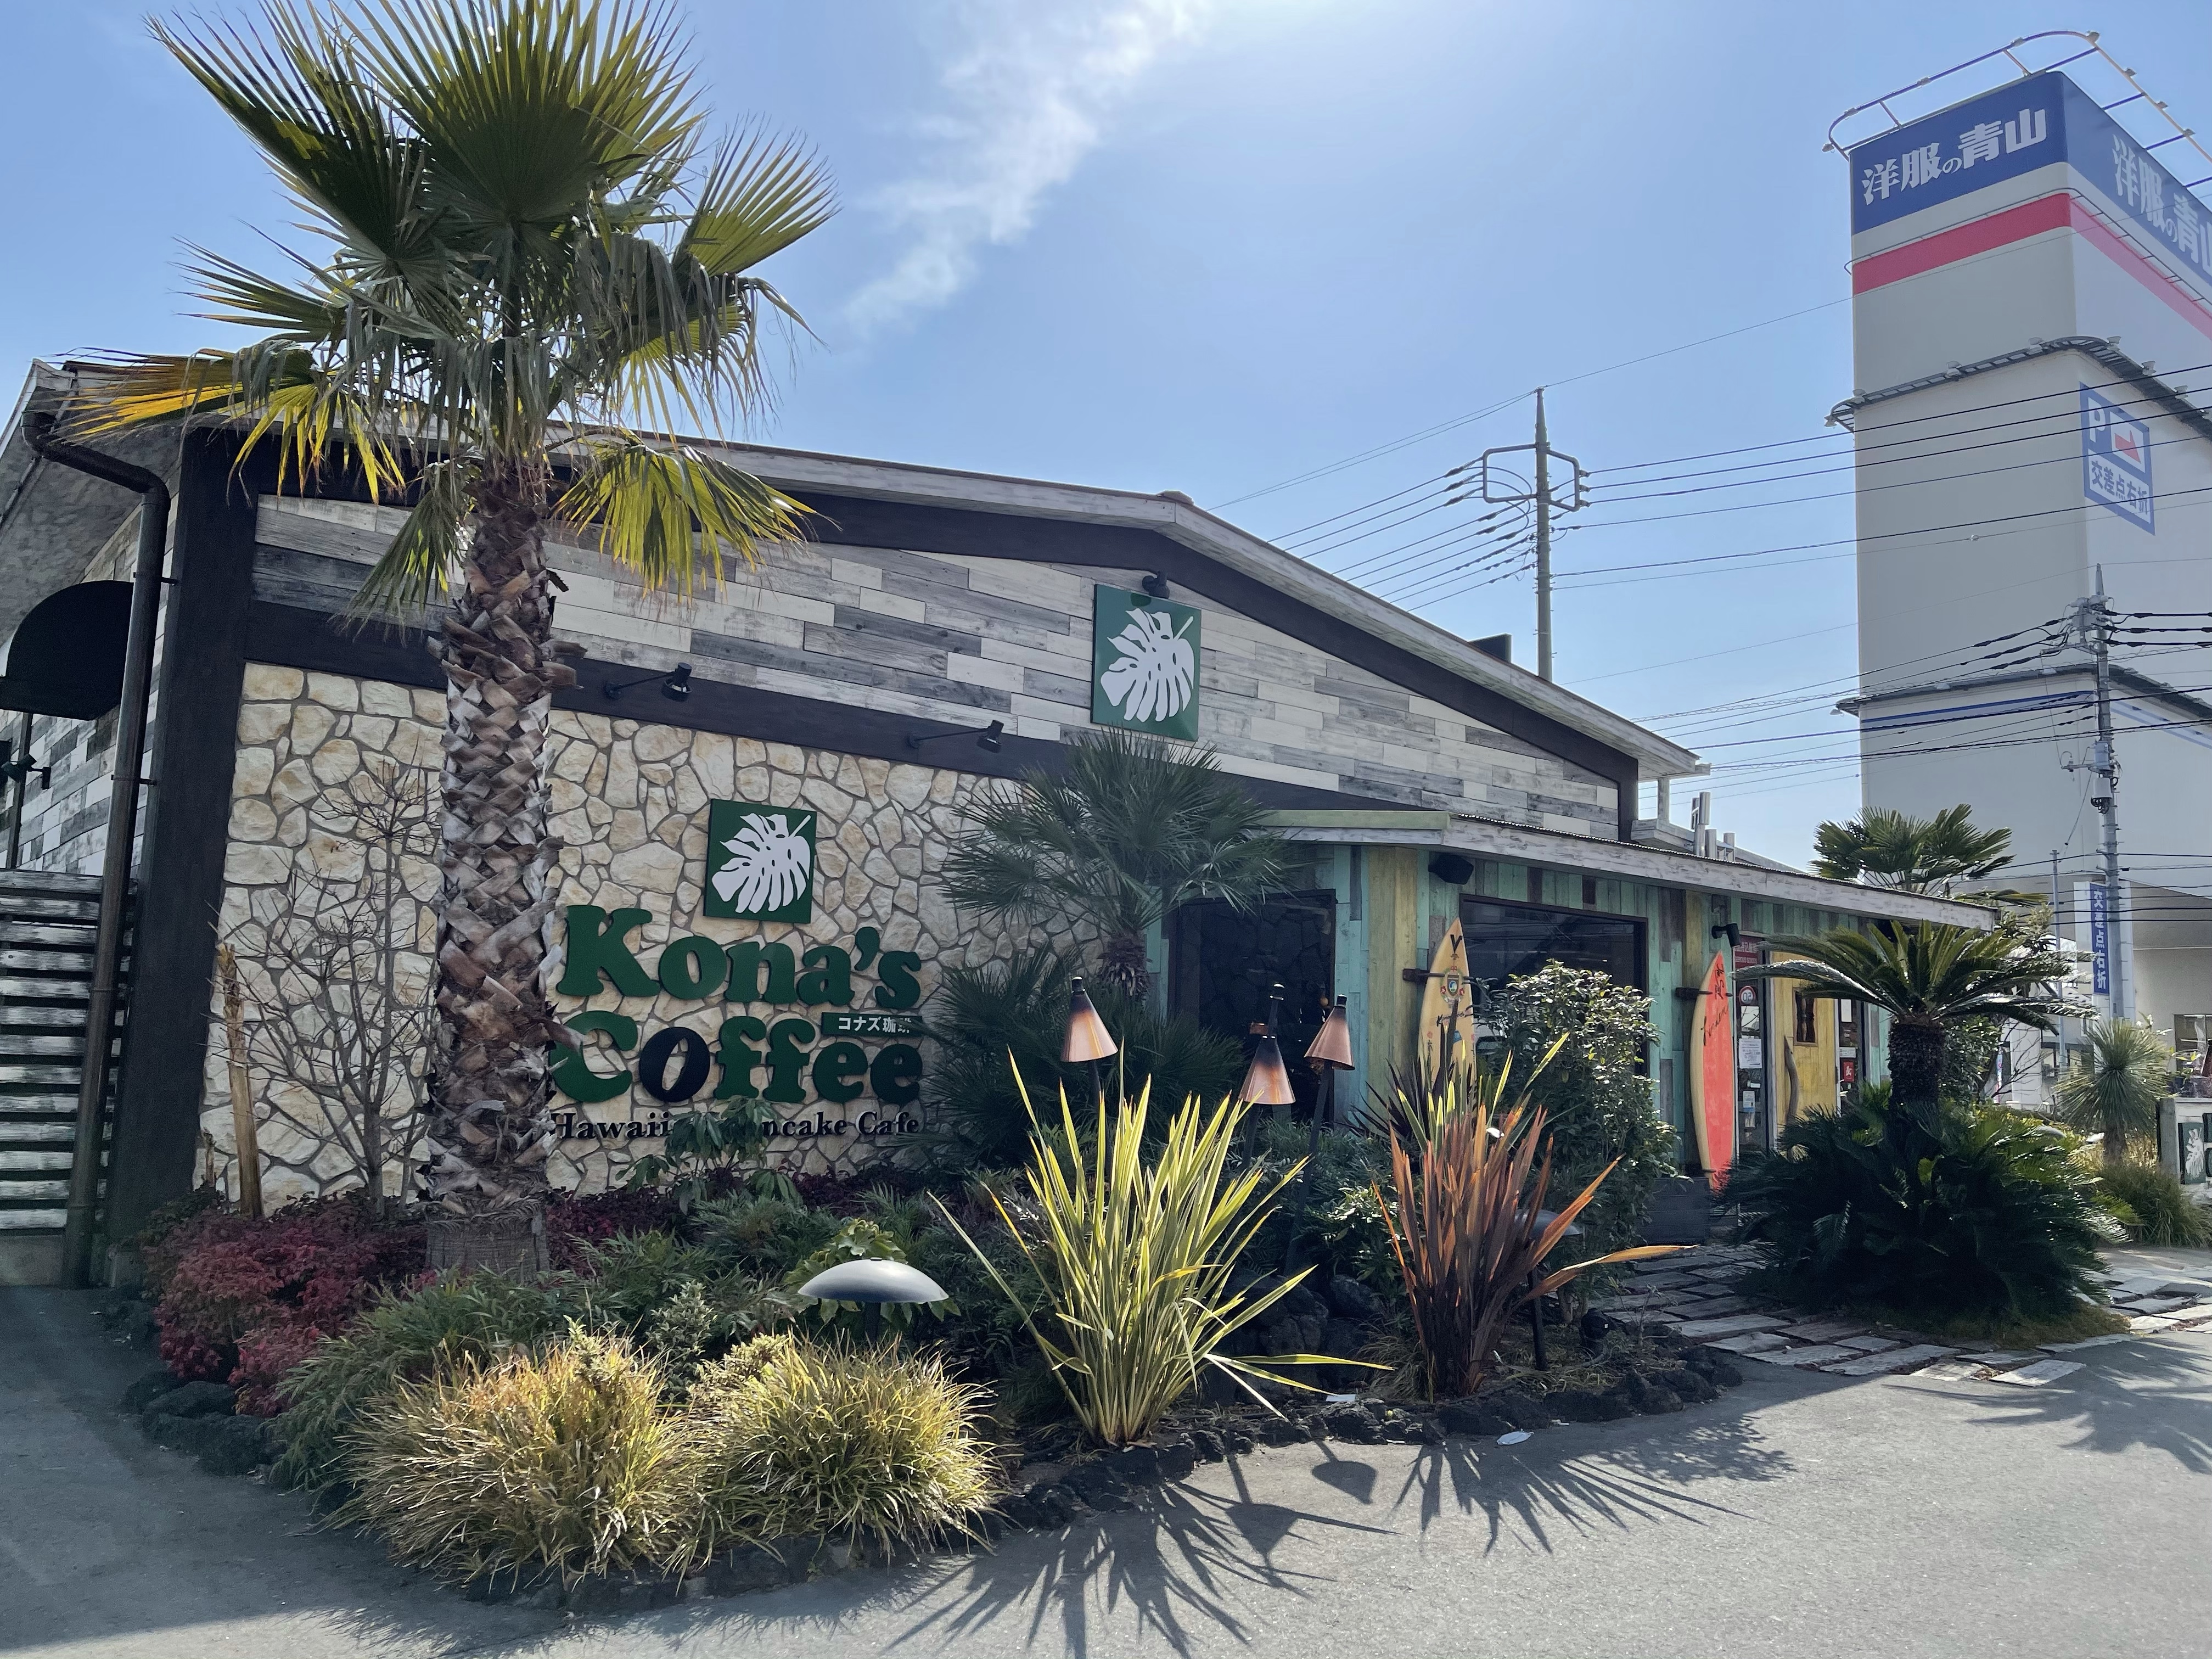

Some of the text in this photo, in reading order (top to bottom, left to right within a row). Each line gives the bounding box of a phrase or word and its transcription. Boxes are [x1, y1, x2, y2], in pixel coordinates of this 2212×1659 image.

[1861, 108, 2047, 205] 洋服の青山
[2087, 396, 2107, 443] P
[2091, 459, 2148, 515] 交差点右折
[556, 905, 922, 1010] Kona's
[2093, 889, 2107, 990] 交差点右折
[549, 1010, 923, 1103] Coffee
[549, 1111, 920, 1139] Hawaii ncake Cafe
